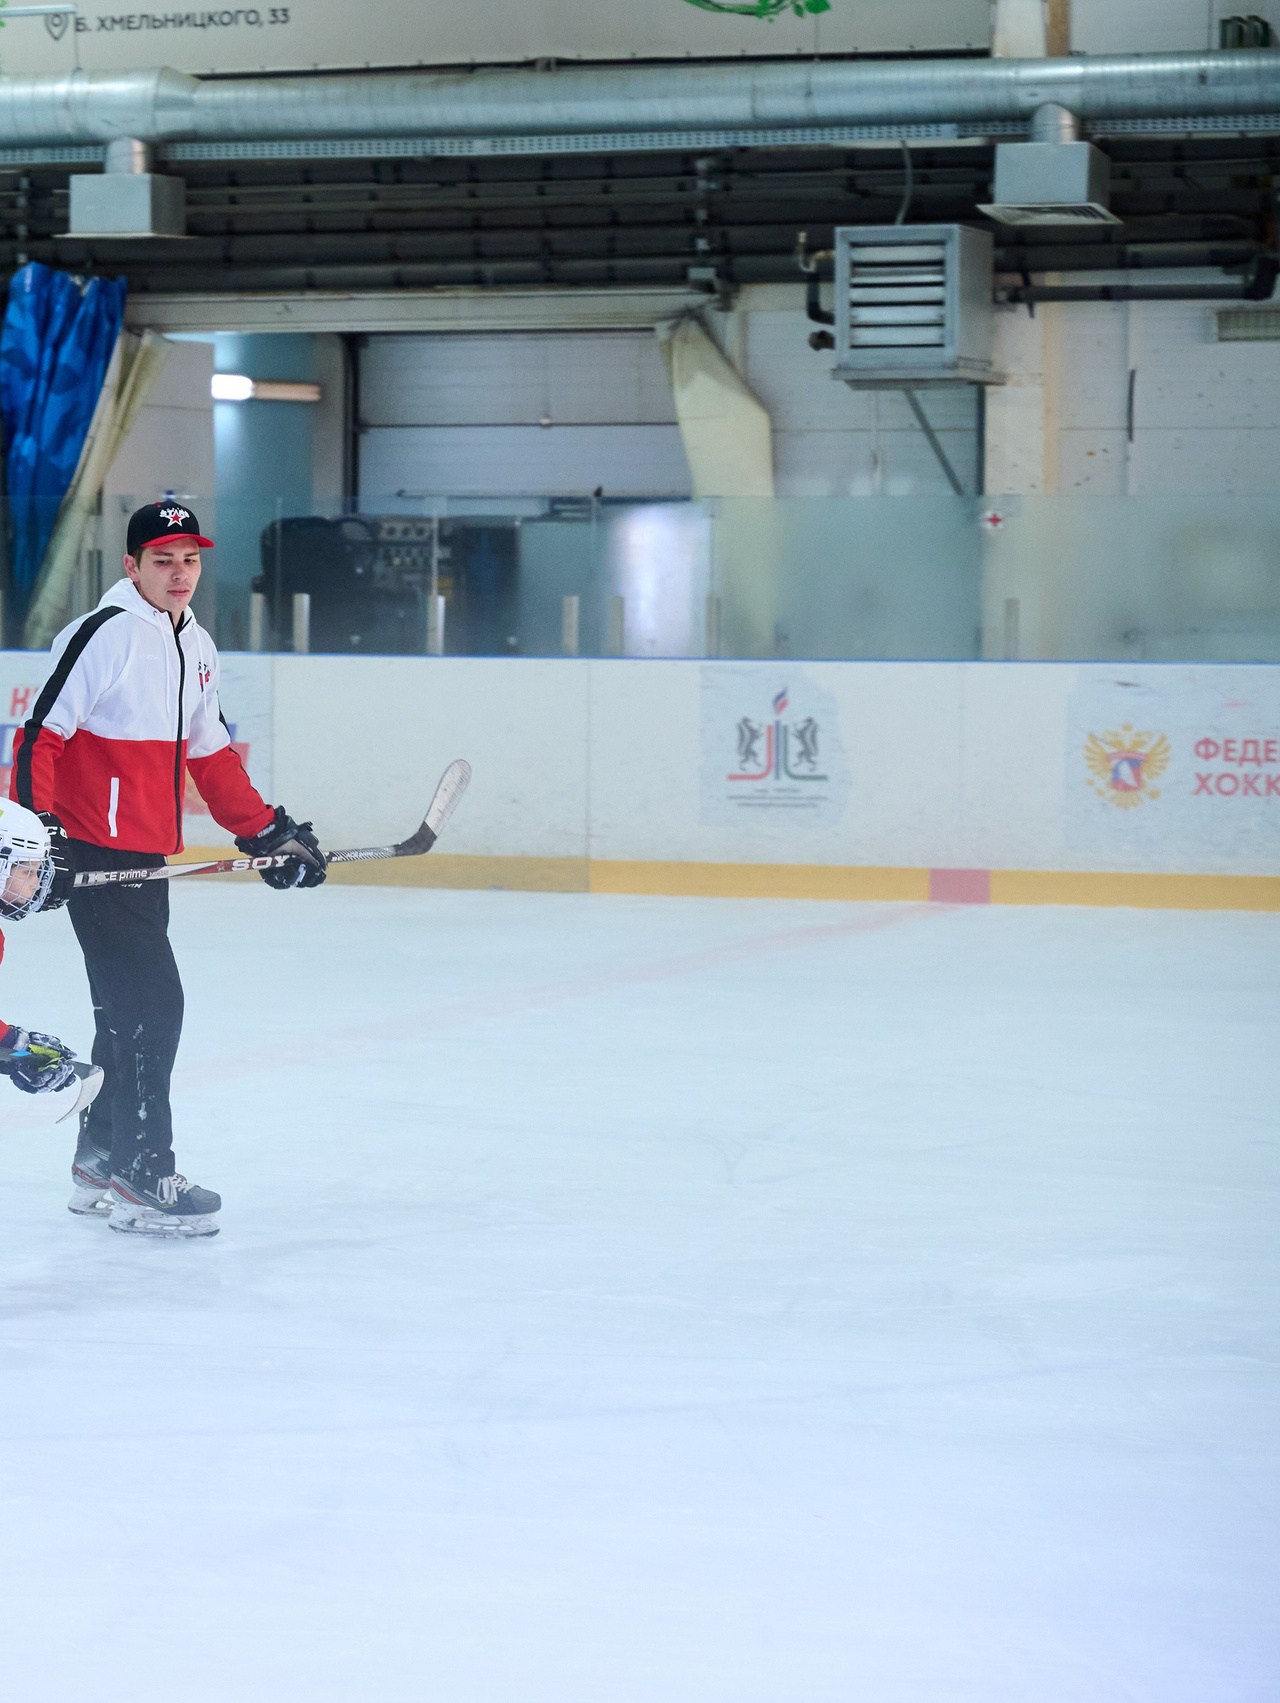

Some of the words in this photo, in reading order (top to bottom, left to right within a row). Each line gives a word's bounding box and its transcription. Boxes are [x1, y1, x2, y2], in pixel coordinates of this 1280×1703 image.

[75, 16, 92, 32] Б.
[96, 9, 264, 32] ХМЕЛЬНИЦКОГО,
[268, 8, 291, 25] 33
[232, 855, 294, 871] SOY
[119, 868, 148, 881] prime
